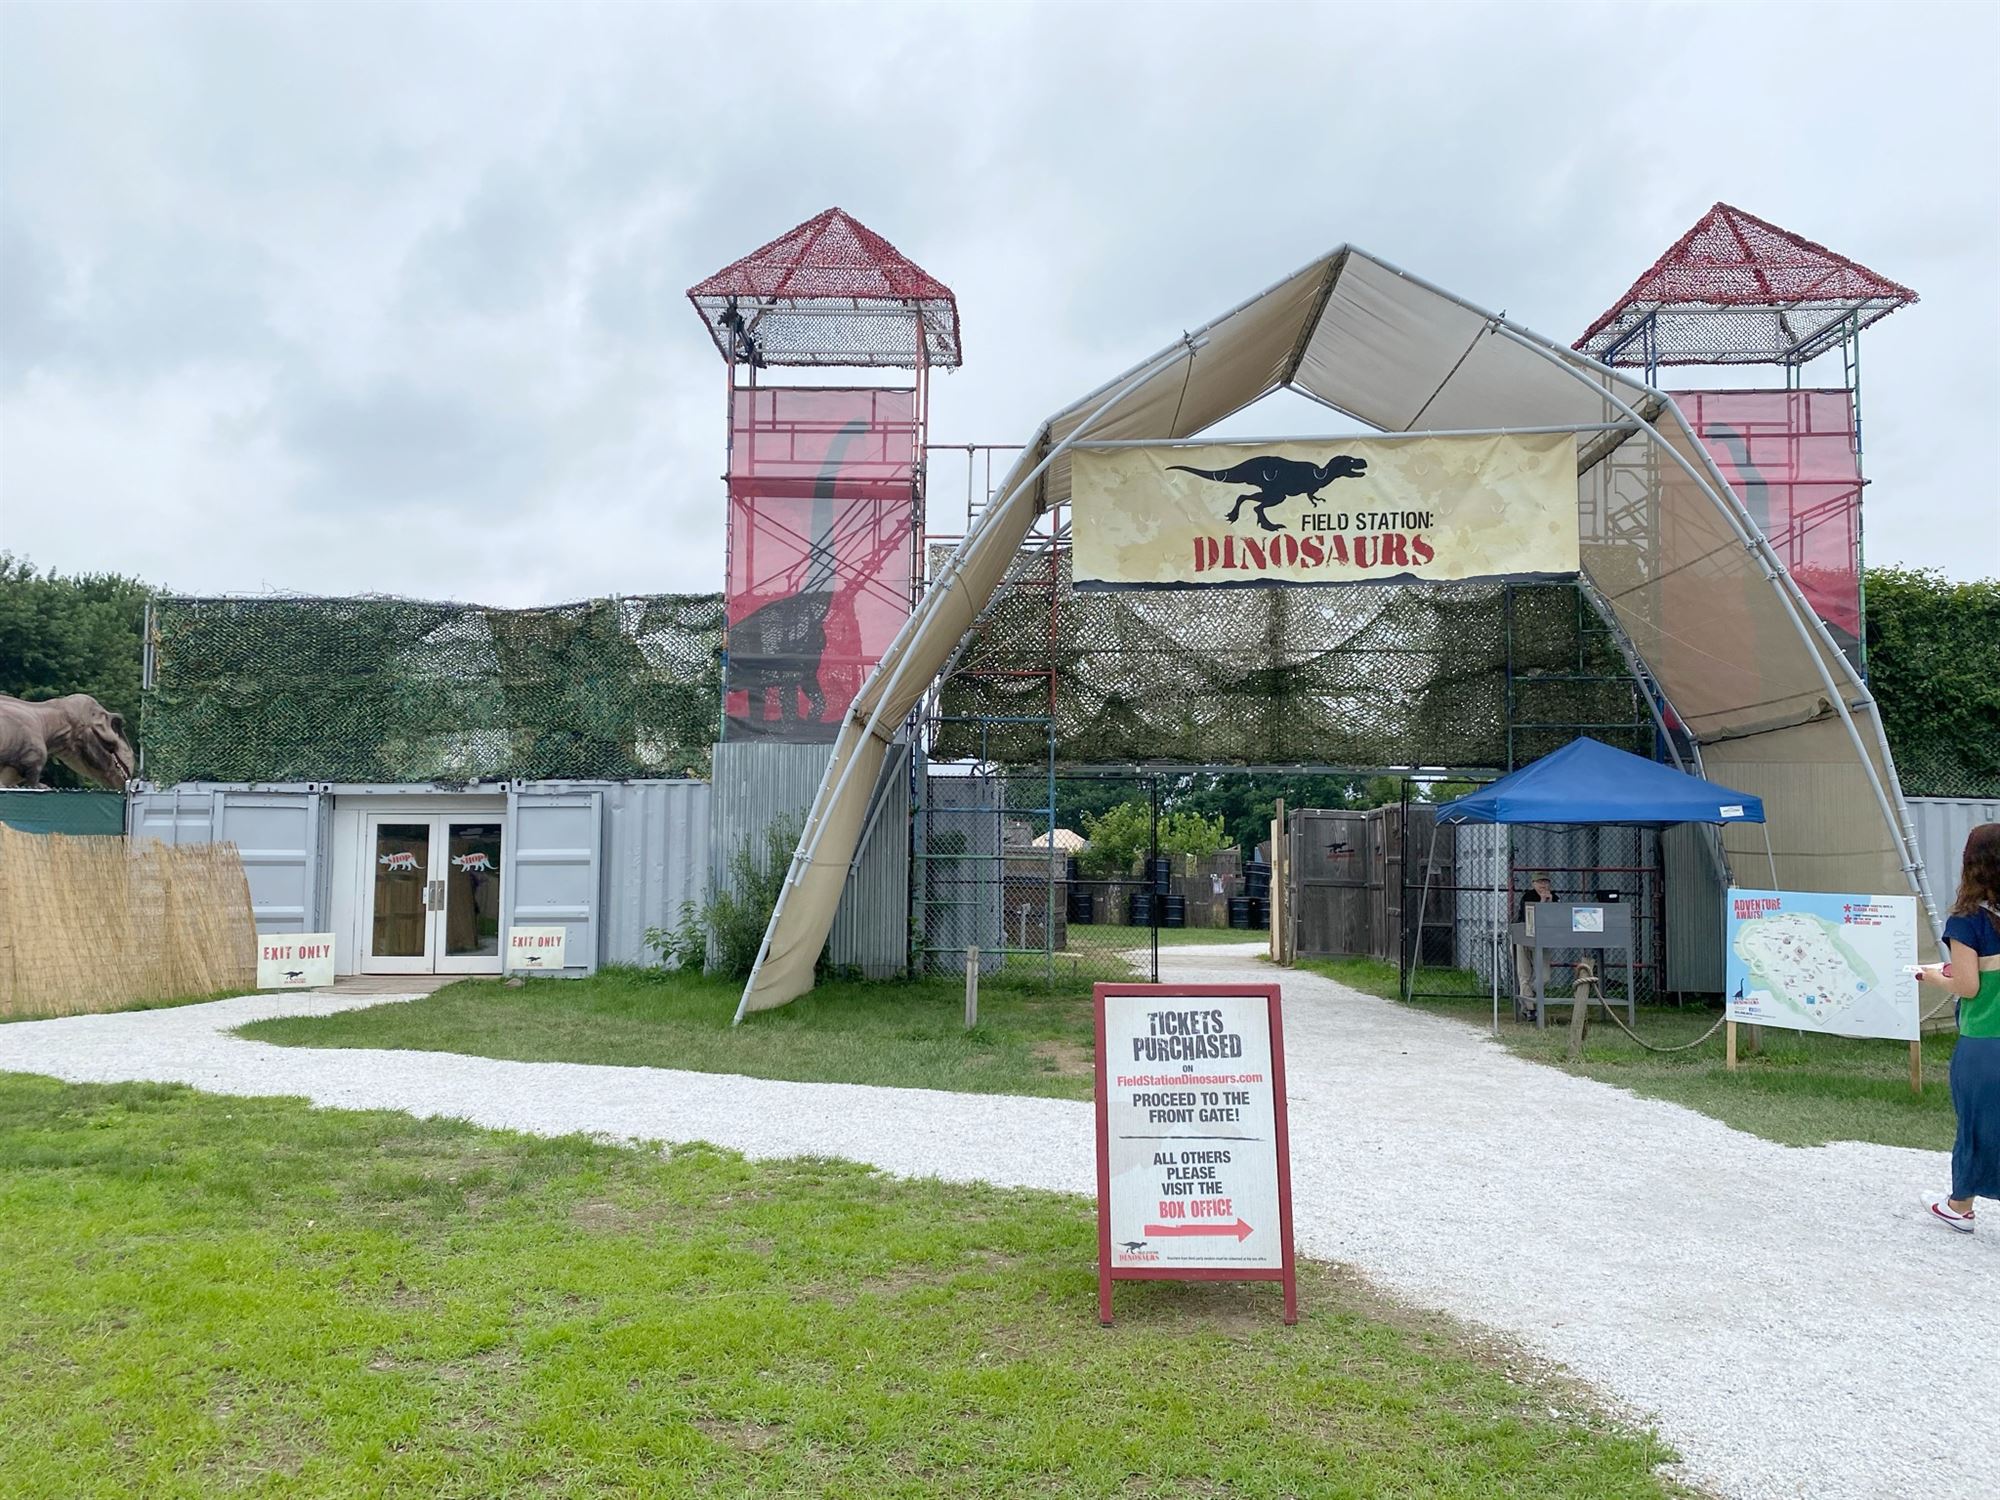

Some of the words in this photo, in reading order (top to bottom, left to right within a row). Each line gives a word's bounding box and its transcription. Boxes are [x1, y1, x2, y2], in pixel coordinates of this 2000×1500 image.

[1301, 512, 1349, 531] FIELD
[1356, 511, 1434, 530] STATION:
[1193, 533, 1435, 572] DINOSAURS
[1734, 898, 1781, 911] ADVENTURE
[513, 936, 533, 947] EXIT
[538, 936, 561, 948] ONLY
[1893, 930, 1912, 959] MAP
[263, 946, 292, 960] EXIT
[299, 945, 330, 959] ONLY
[1147, 1010, 1224, 1036] TICKETS
[1132, 1034, 1242, 1062] PURCHASED
[1182, 1064, 1193, 1073] ON
[1117, 1073, 1263, 1087] FieldStationDinosaurs.com
[1133, 1092, 1196, 1107] PROCEED
[1200, 1092, 1218, 1106] TO
[1223, 1091, 1250, 1105] THE
[1149, 1109, 1194, 1123] FRONT
[1199, 1108, 1240, 1122] GATE!
[1153, 1152, 1177, 1165] ALL
[1181, 1150, 1231, 1164] OTHERS
[1167, 1166, 1216, 1180] PLEASE
[1161, 1182, 1194, 1195] VISIT
[1198, 1181, 1223, 1195] THE
[1159, 1201, 1185, 1218] BOX
[1191, 1199, 1233, 1218] OFFICE
